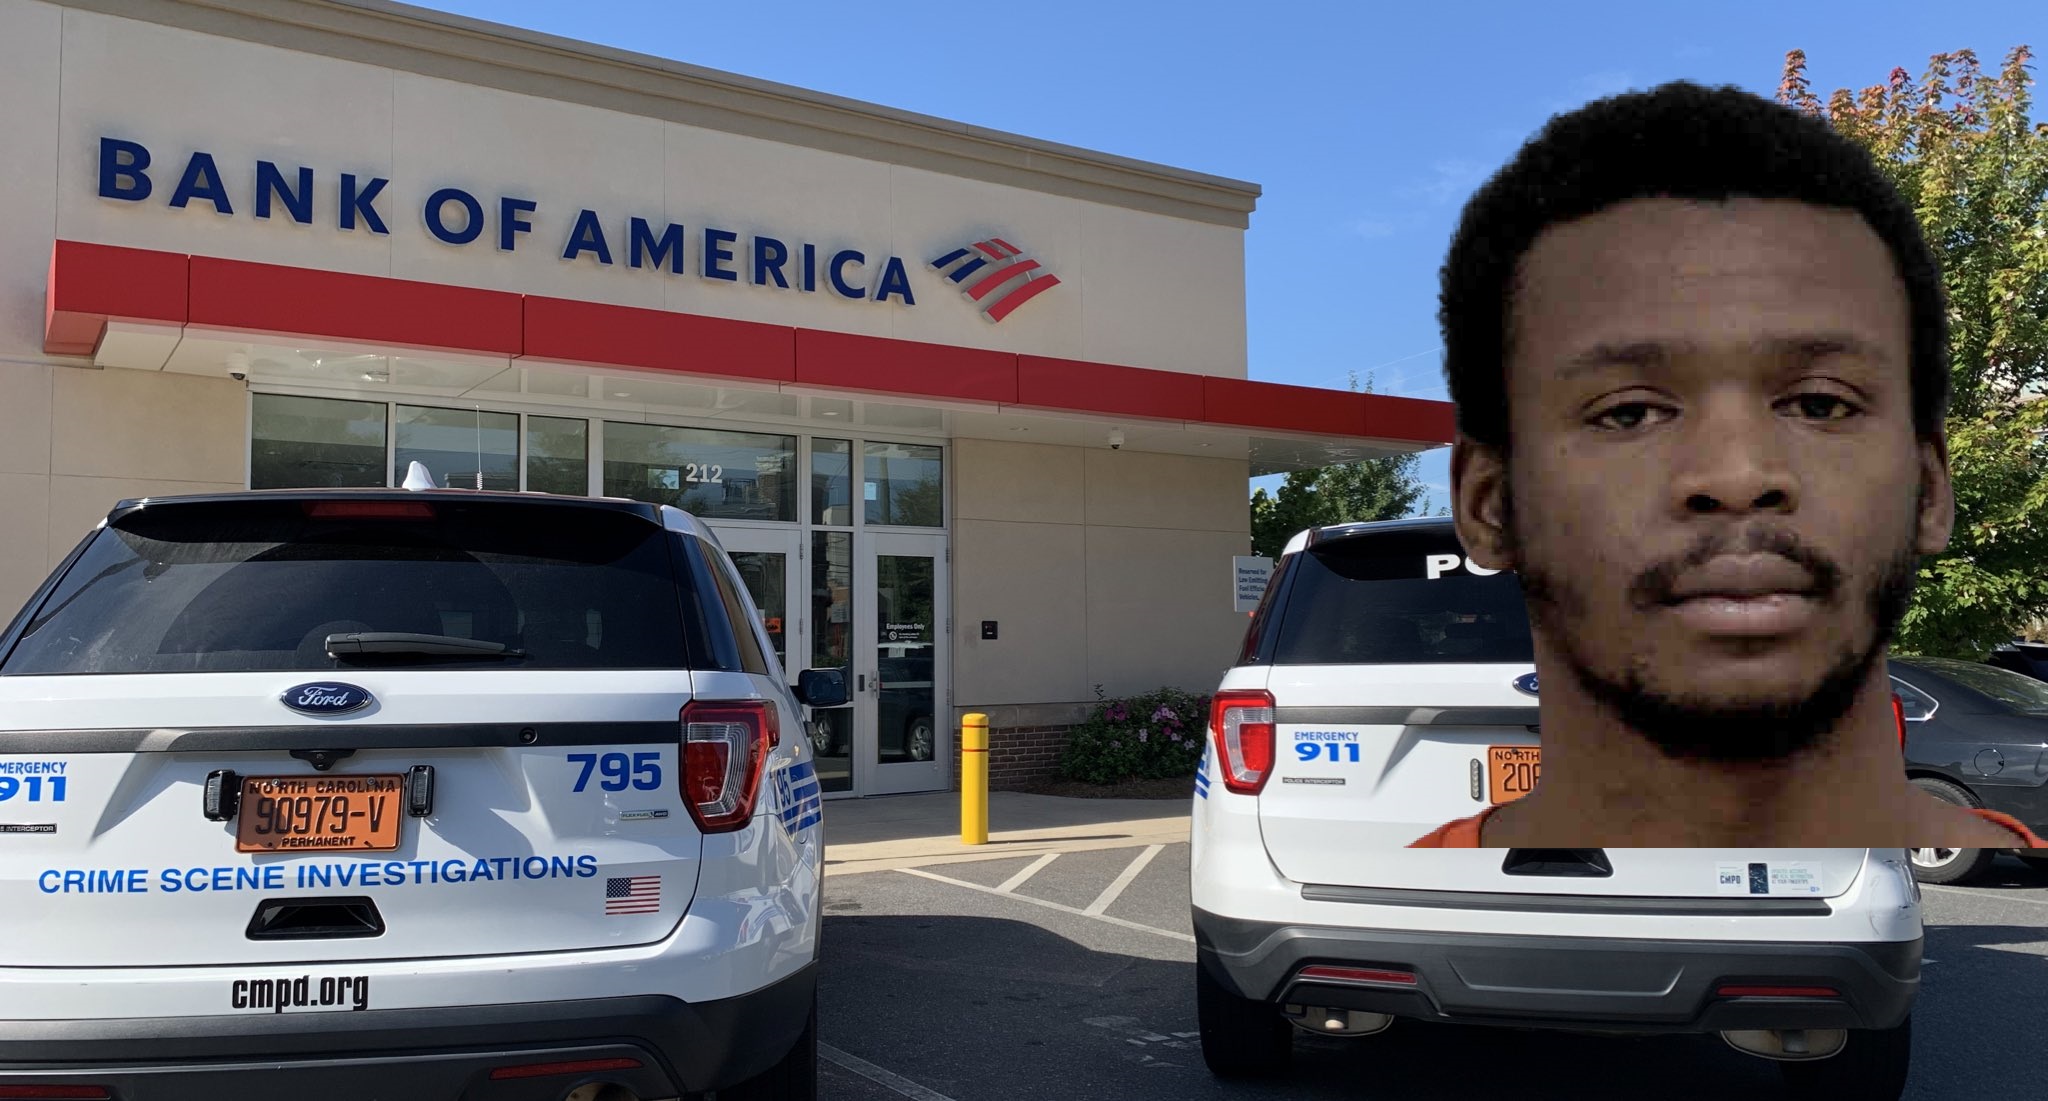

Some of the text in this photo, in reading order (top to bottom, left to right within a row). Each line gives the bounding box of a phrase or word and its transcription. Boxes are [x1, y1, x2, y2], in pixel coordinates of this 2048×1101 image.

[99, 137, 916, 306] BANK OF AMERICA
[686, 463, 722, 483] 212
[298, 686, 348, 707] Ford
[1294, 731, 1359, 741] EMERGENCY
[1295, 742, 1360, 762] 911
[1495, 751, 1540, 760] NORTH
[567, 752, 662, 793] 795
[0, 776, 67, 801] 911
[250, 780, 396, 795] NORTH CAROLINA
[255, 795, 386, 835] 90979-V
[281, 836, 357, 848] PERMANENT
[39, 854, 598, 894] CRIME SCENE INVESTIGATIONS
[232, 974, 370, 1014] cmpd.org
